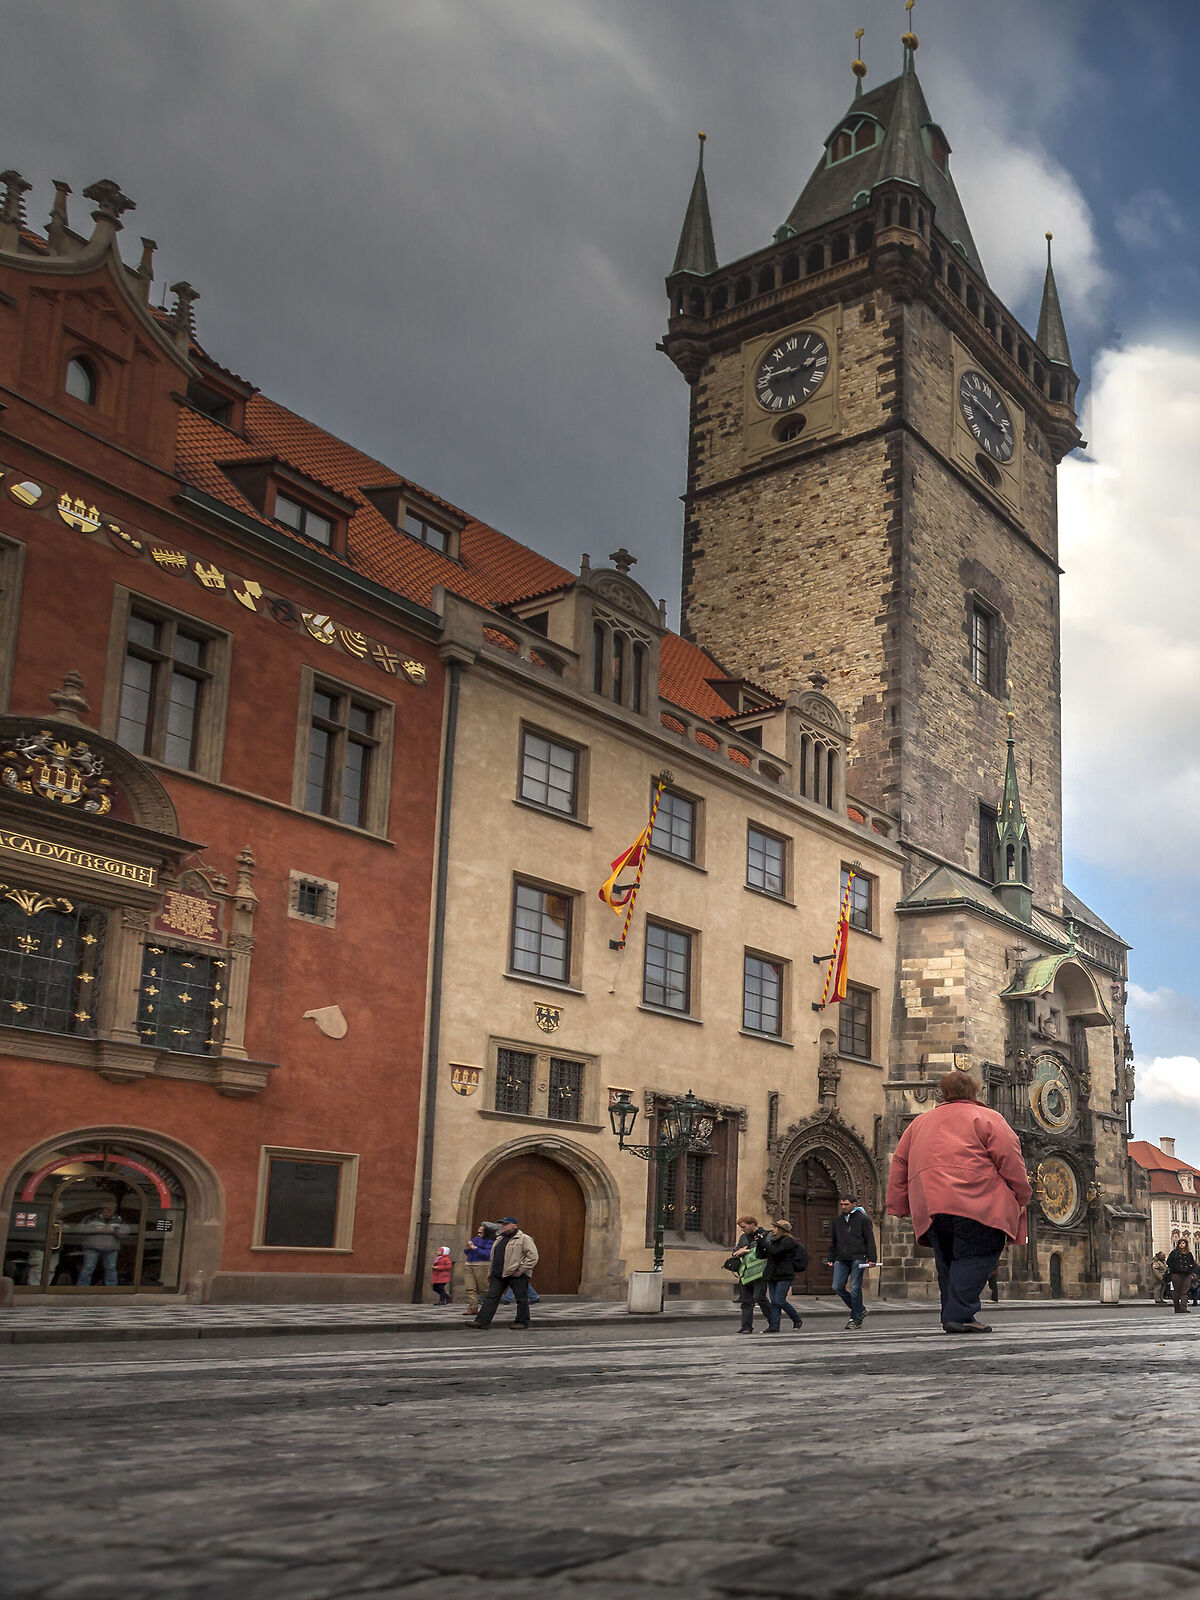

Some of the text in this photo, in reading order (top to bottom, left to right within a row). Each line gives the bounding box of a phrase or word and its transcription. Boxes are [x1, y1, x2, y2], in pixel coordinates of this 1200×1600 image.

[773, 348, 784, 362] XI
[762, 364, 774, 373] X
[810, 370, 824, 383] IIII
[802, 387, 811, 396] V
